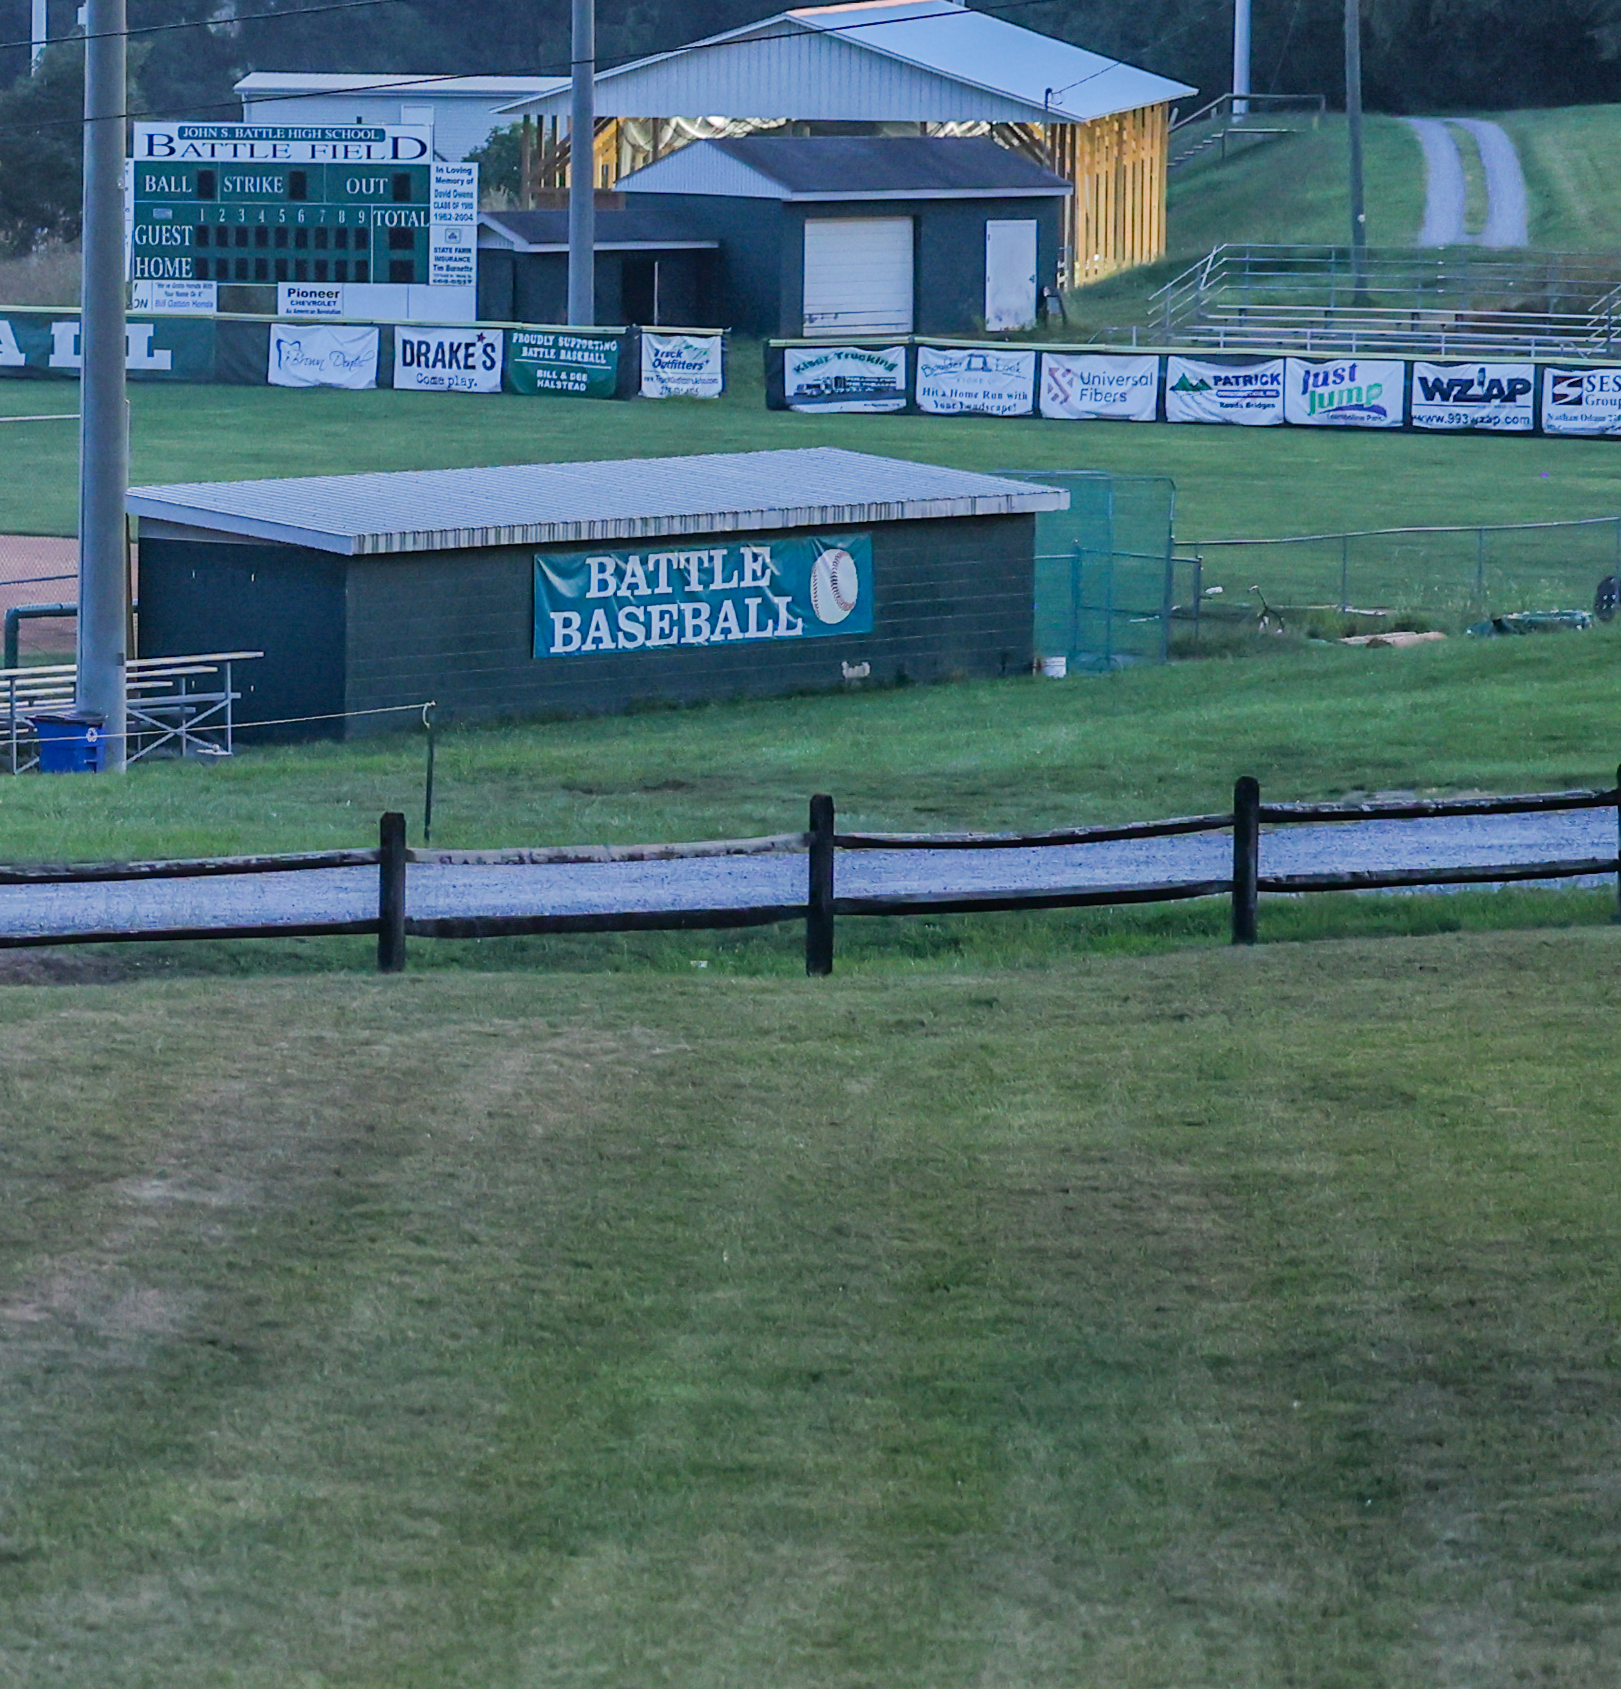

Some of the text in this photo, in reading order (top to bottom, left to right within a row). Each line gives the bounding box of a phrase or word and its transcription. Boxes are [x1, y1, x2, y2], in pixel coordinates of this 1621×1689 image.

[182, 127, 379, 140] JOHN S. BATTLE HIGH SCHOOL
[145, 133, 428, 161] BATTLE FIELD
[145, 175, 388, 195] BALL STRIKE OUT
[200, 208, 430, 227] 1 2 3 4 5 6 7 8 9 TOTAL
[134, 224, 193, 246] GUEST
[135, 257, 193, 278] HOME
[287, 287, 341, 299] Pioneer
[512, 332, 618, 352] PROUDLY SUPPORTING
[520, 346, 607, 364] BATTLE BASEBALL
[834, 351, 899, 372] Trucking
[416, 372, 478, 389] Come play.
[536, 369, 558, 380] BILL
[1079, 370, 1153, 386] Universal
[1213, 372, 1281, 387] PATRICK
[1301, 362, 1358, 396] Just
[922, 387, 939, 397] Hit
[949, 388, 979, 400] Home
[982, 389, 1003, 400] Run
[1006, 390, 1028, 401] with
[1079, 388, 1128, 403] Fibers
[1417, 376, 1532, 403] WZAP
[933, 399, 957, 410] Your
[1306, 382, 1383, 417] Jump
[585, 545, 772, 599] BATTLE
[549, 596, 804, 654] BASEBALL
